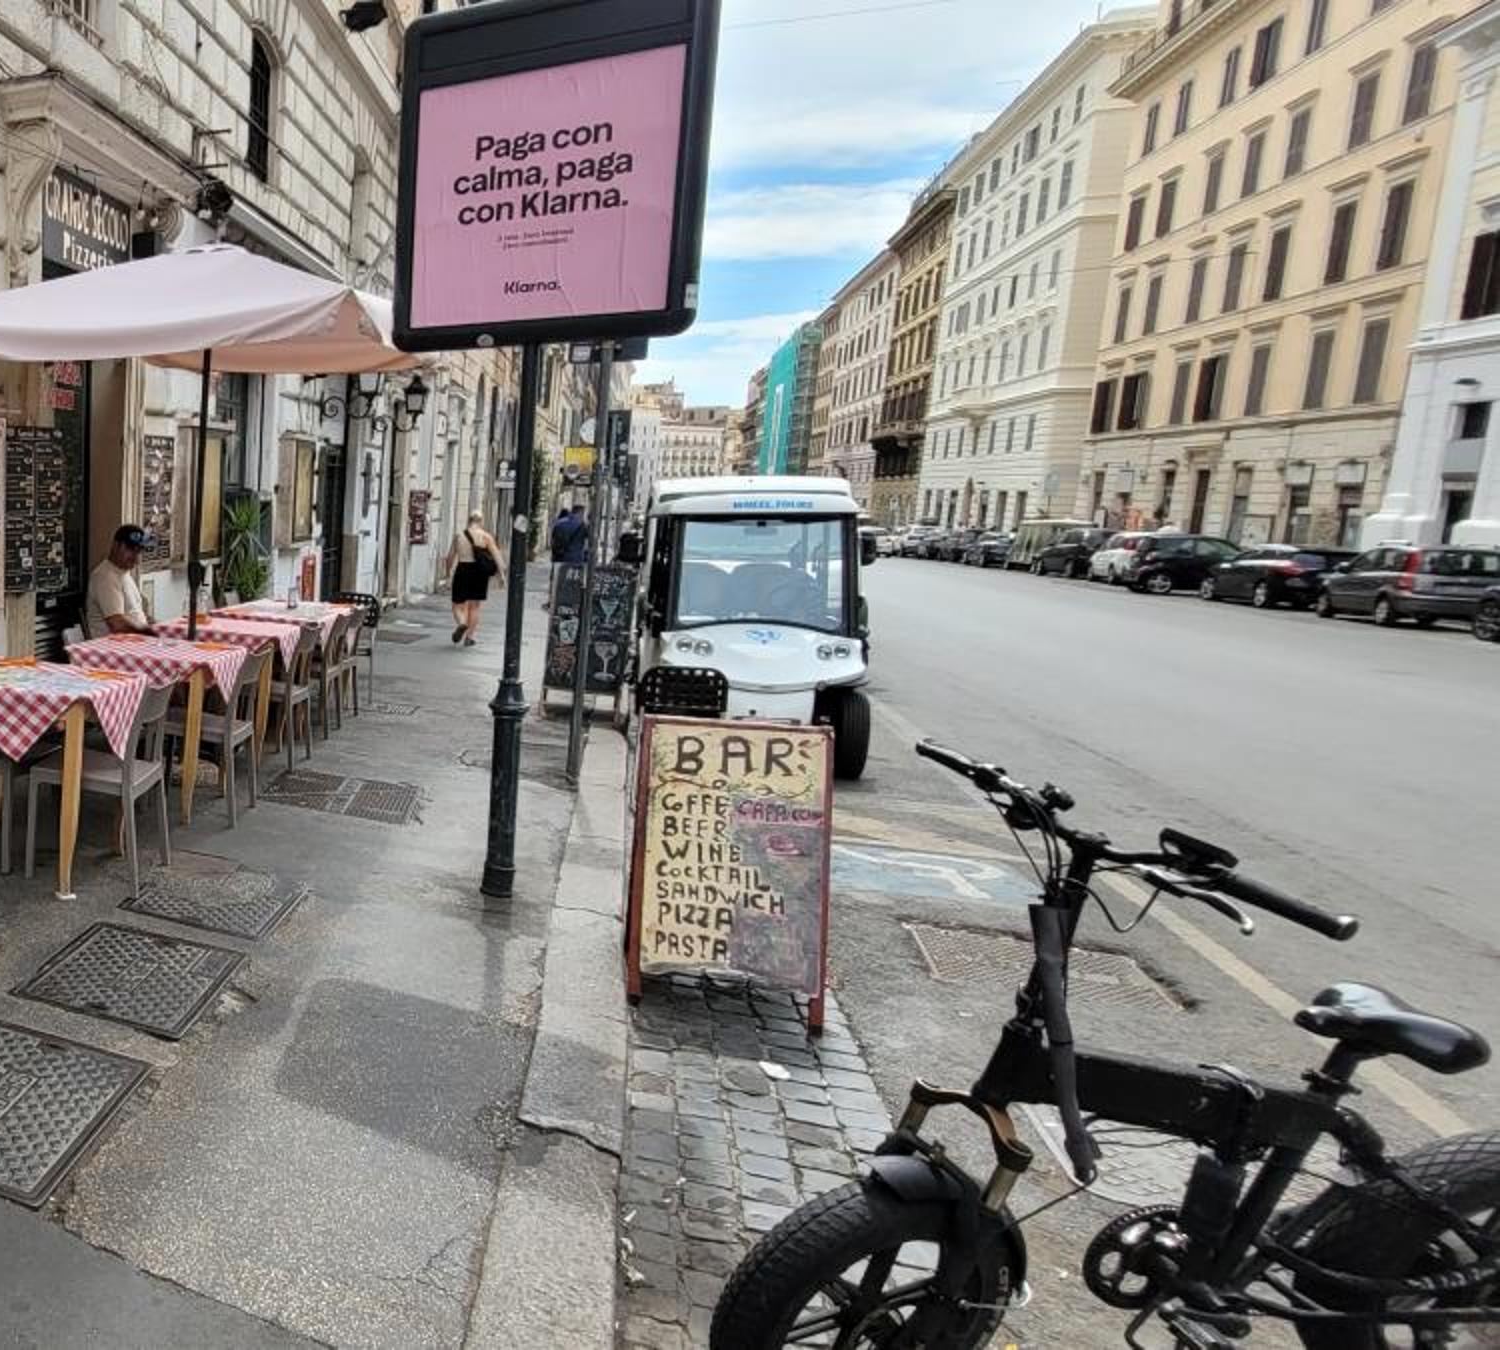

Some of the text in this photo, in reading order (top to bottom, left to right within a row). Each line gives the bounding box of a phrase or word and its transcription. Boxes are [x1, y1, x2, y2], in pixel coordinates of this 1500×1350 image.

[475, 121, 613, 161] Paga con
[453, 151, 633, 195] calma, paga
[458, 187, 628, 225] con Klarna.
[503, 280, 562, 294] Klarna.
[673, 735, 793, 777] BAR
[662, 840, 741, 864] WINE
[658, 901, 733, 930] PIZZA
[654, 930, 728, 961] PASTA
